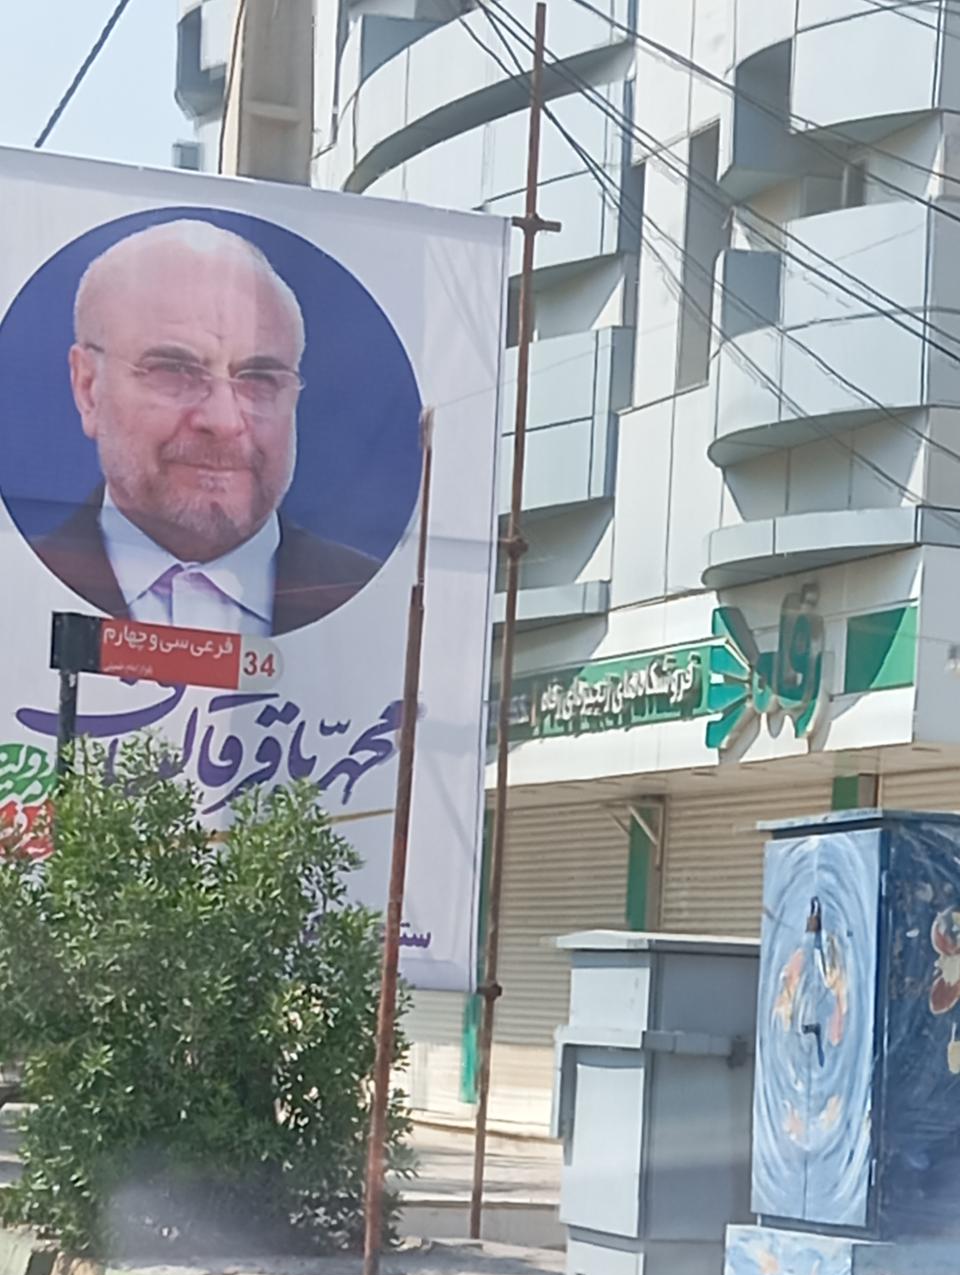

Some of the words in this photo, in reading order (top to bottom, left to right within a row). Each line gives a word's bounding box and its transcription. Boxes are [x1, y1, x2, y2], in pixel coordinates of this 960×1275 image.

[103, 625, 147, 650] چهارم
[149, 633, 158, 650] و
[160, 638, 189, 653] سی
[189, 636, 233, 659] فرعی
[243, 651, 276, 677] 34
